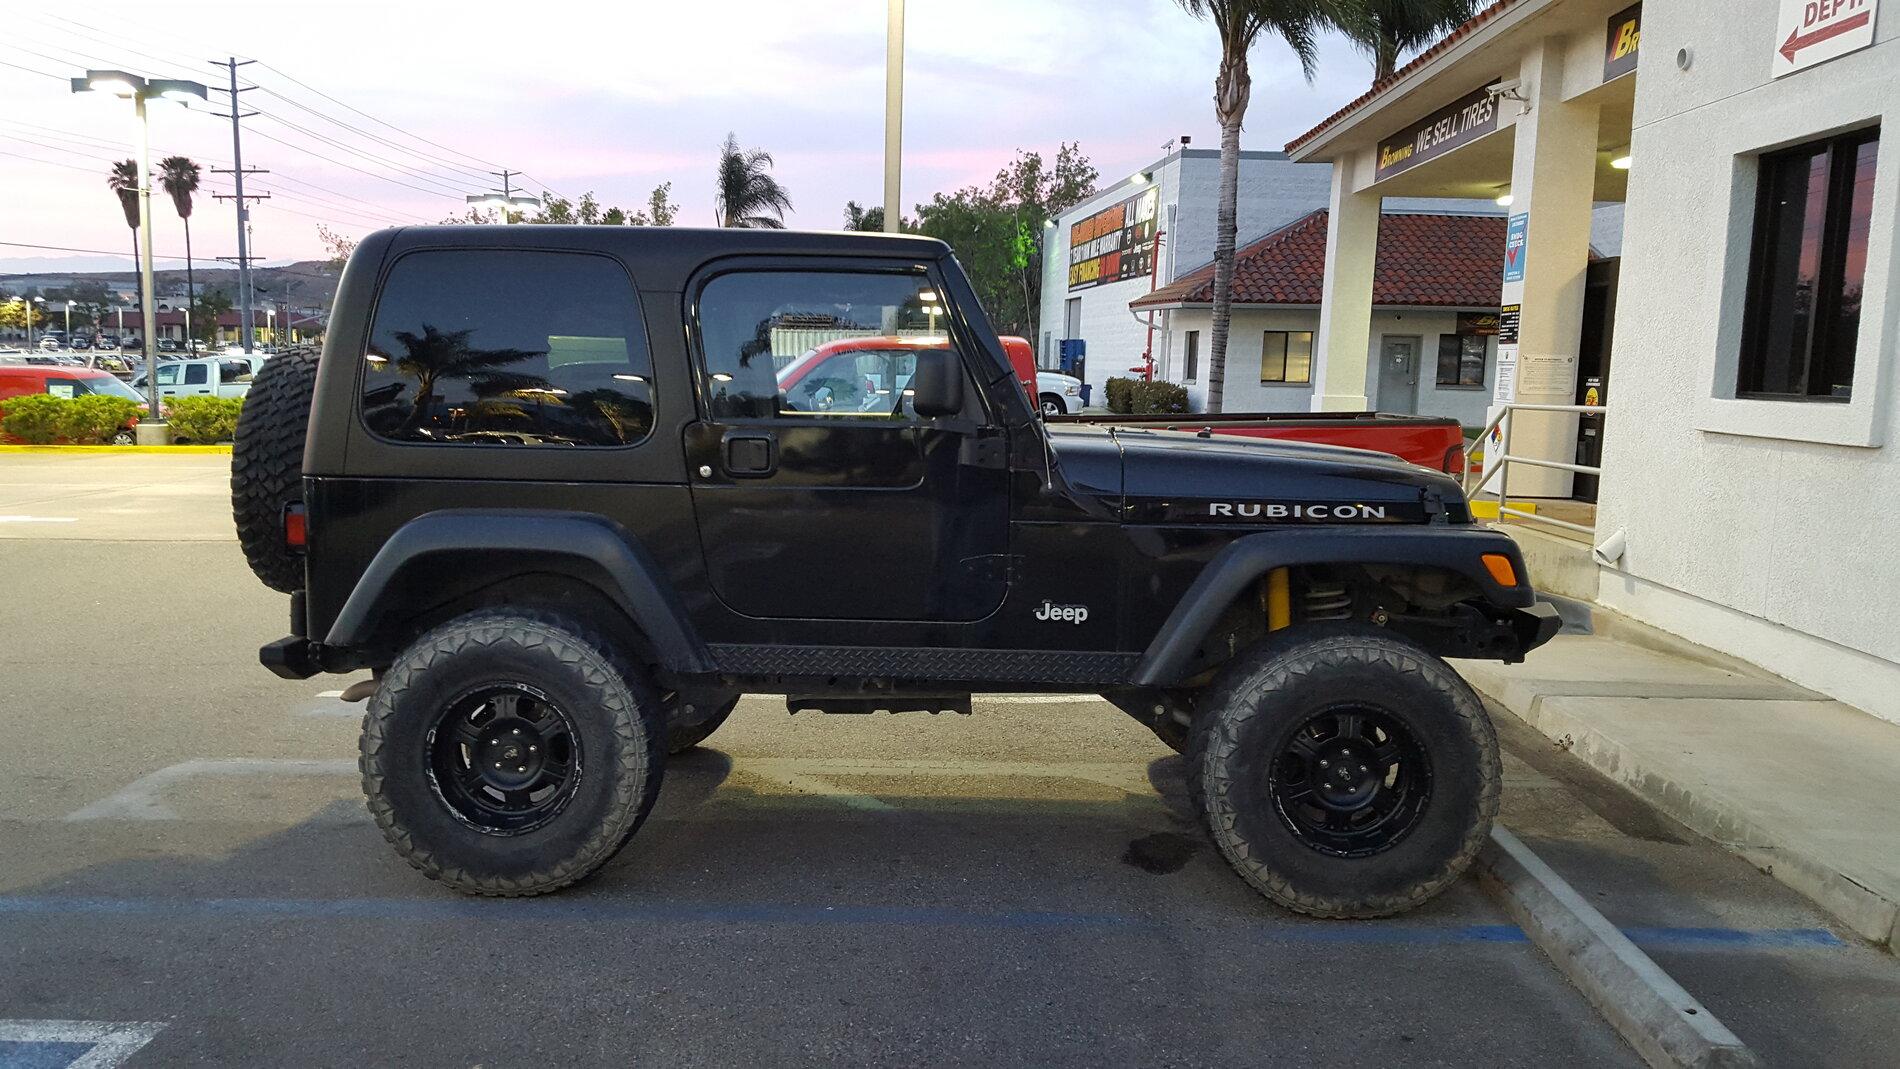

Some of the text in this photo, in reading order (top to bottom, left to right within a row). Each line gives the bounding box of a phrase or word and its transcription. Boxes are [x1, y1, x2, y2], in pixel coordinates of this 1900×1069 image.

[1416, 126, 1433, 153] WE
[1432, 114, 1458, 146] SELL
[1460, 97, 1495, 133] TIRES
[1209, 502, 1385, 519] RUBICON
[1035, 602, 1088, 625] Jeep
